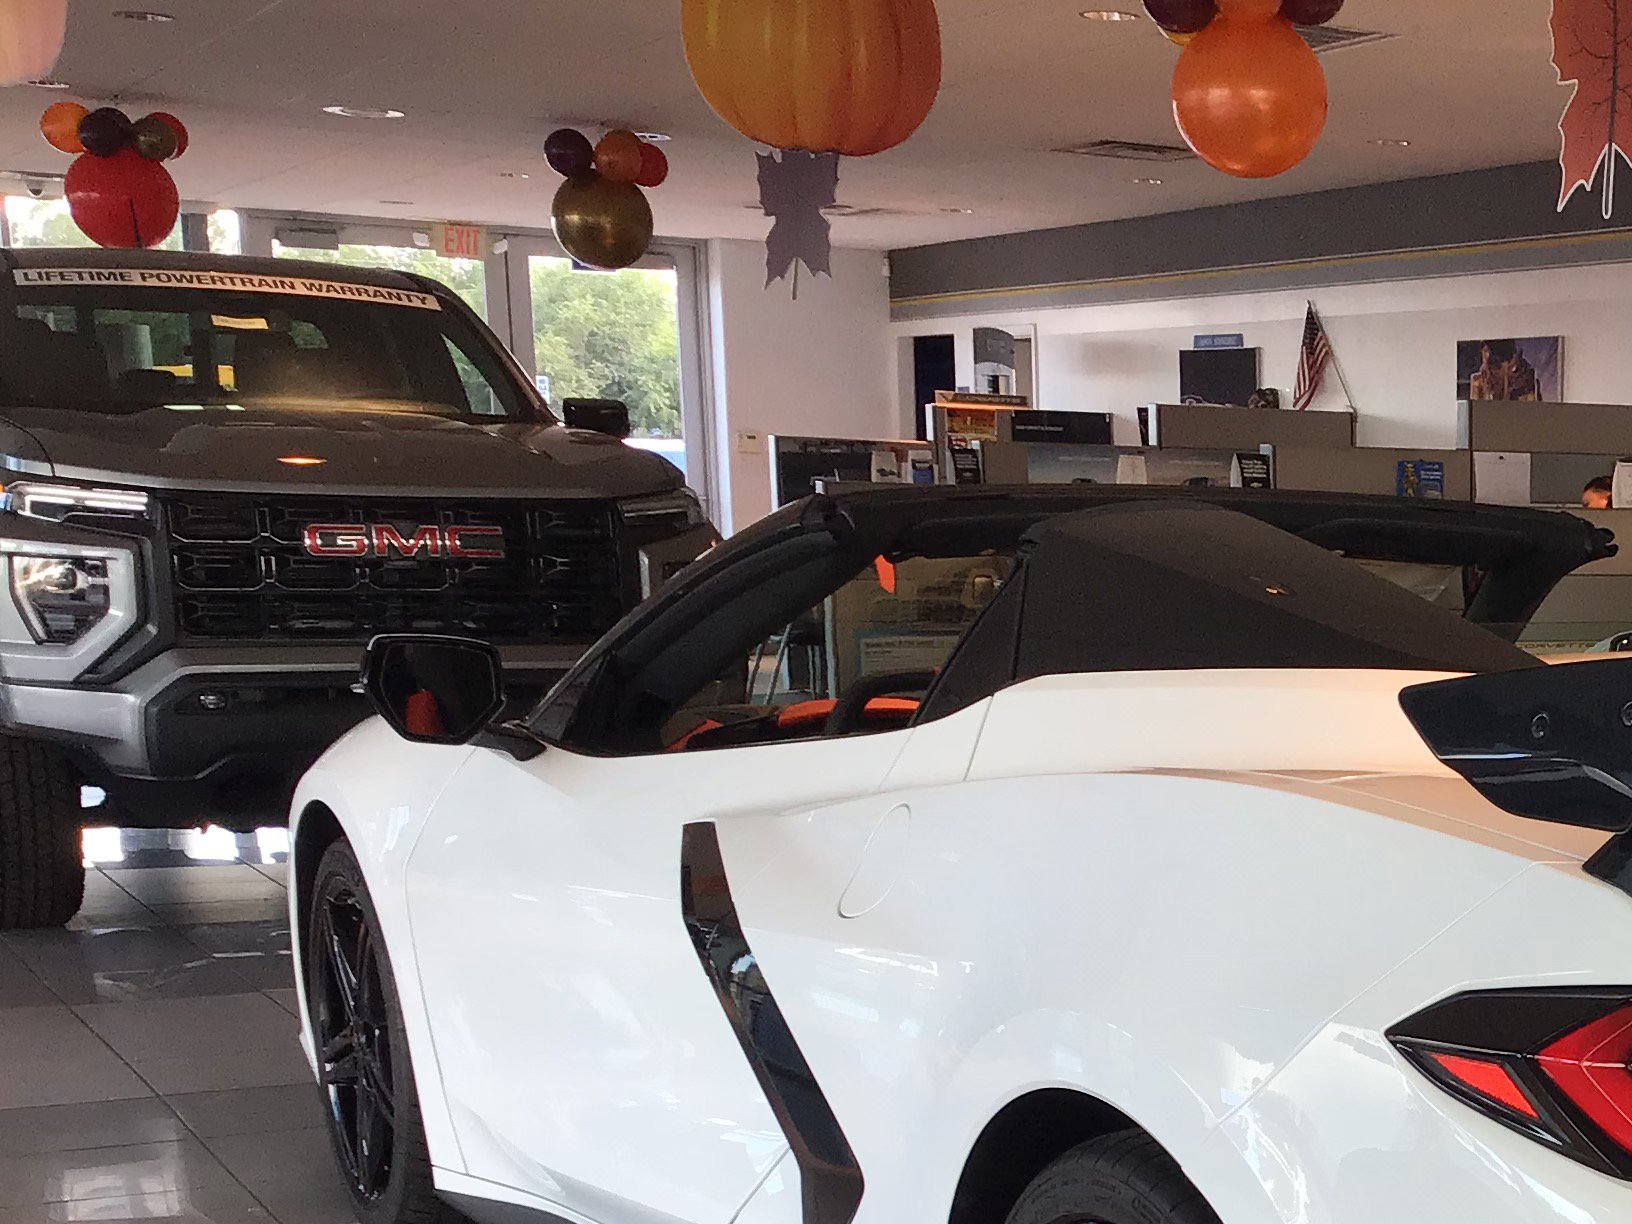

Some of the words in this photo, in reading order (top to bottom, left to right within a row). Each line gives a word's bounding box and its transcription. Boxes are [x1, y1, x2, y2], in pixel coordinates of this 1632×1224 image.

[444, 226, 481, 256] EXIT
[22, 271, 134, 282] LIFETIME
[139, 272, 296, 290] POWERTRAIN
[301, 281, 428, 305] WARRANTY
[303, 523, 505, 558] GMC
